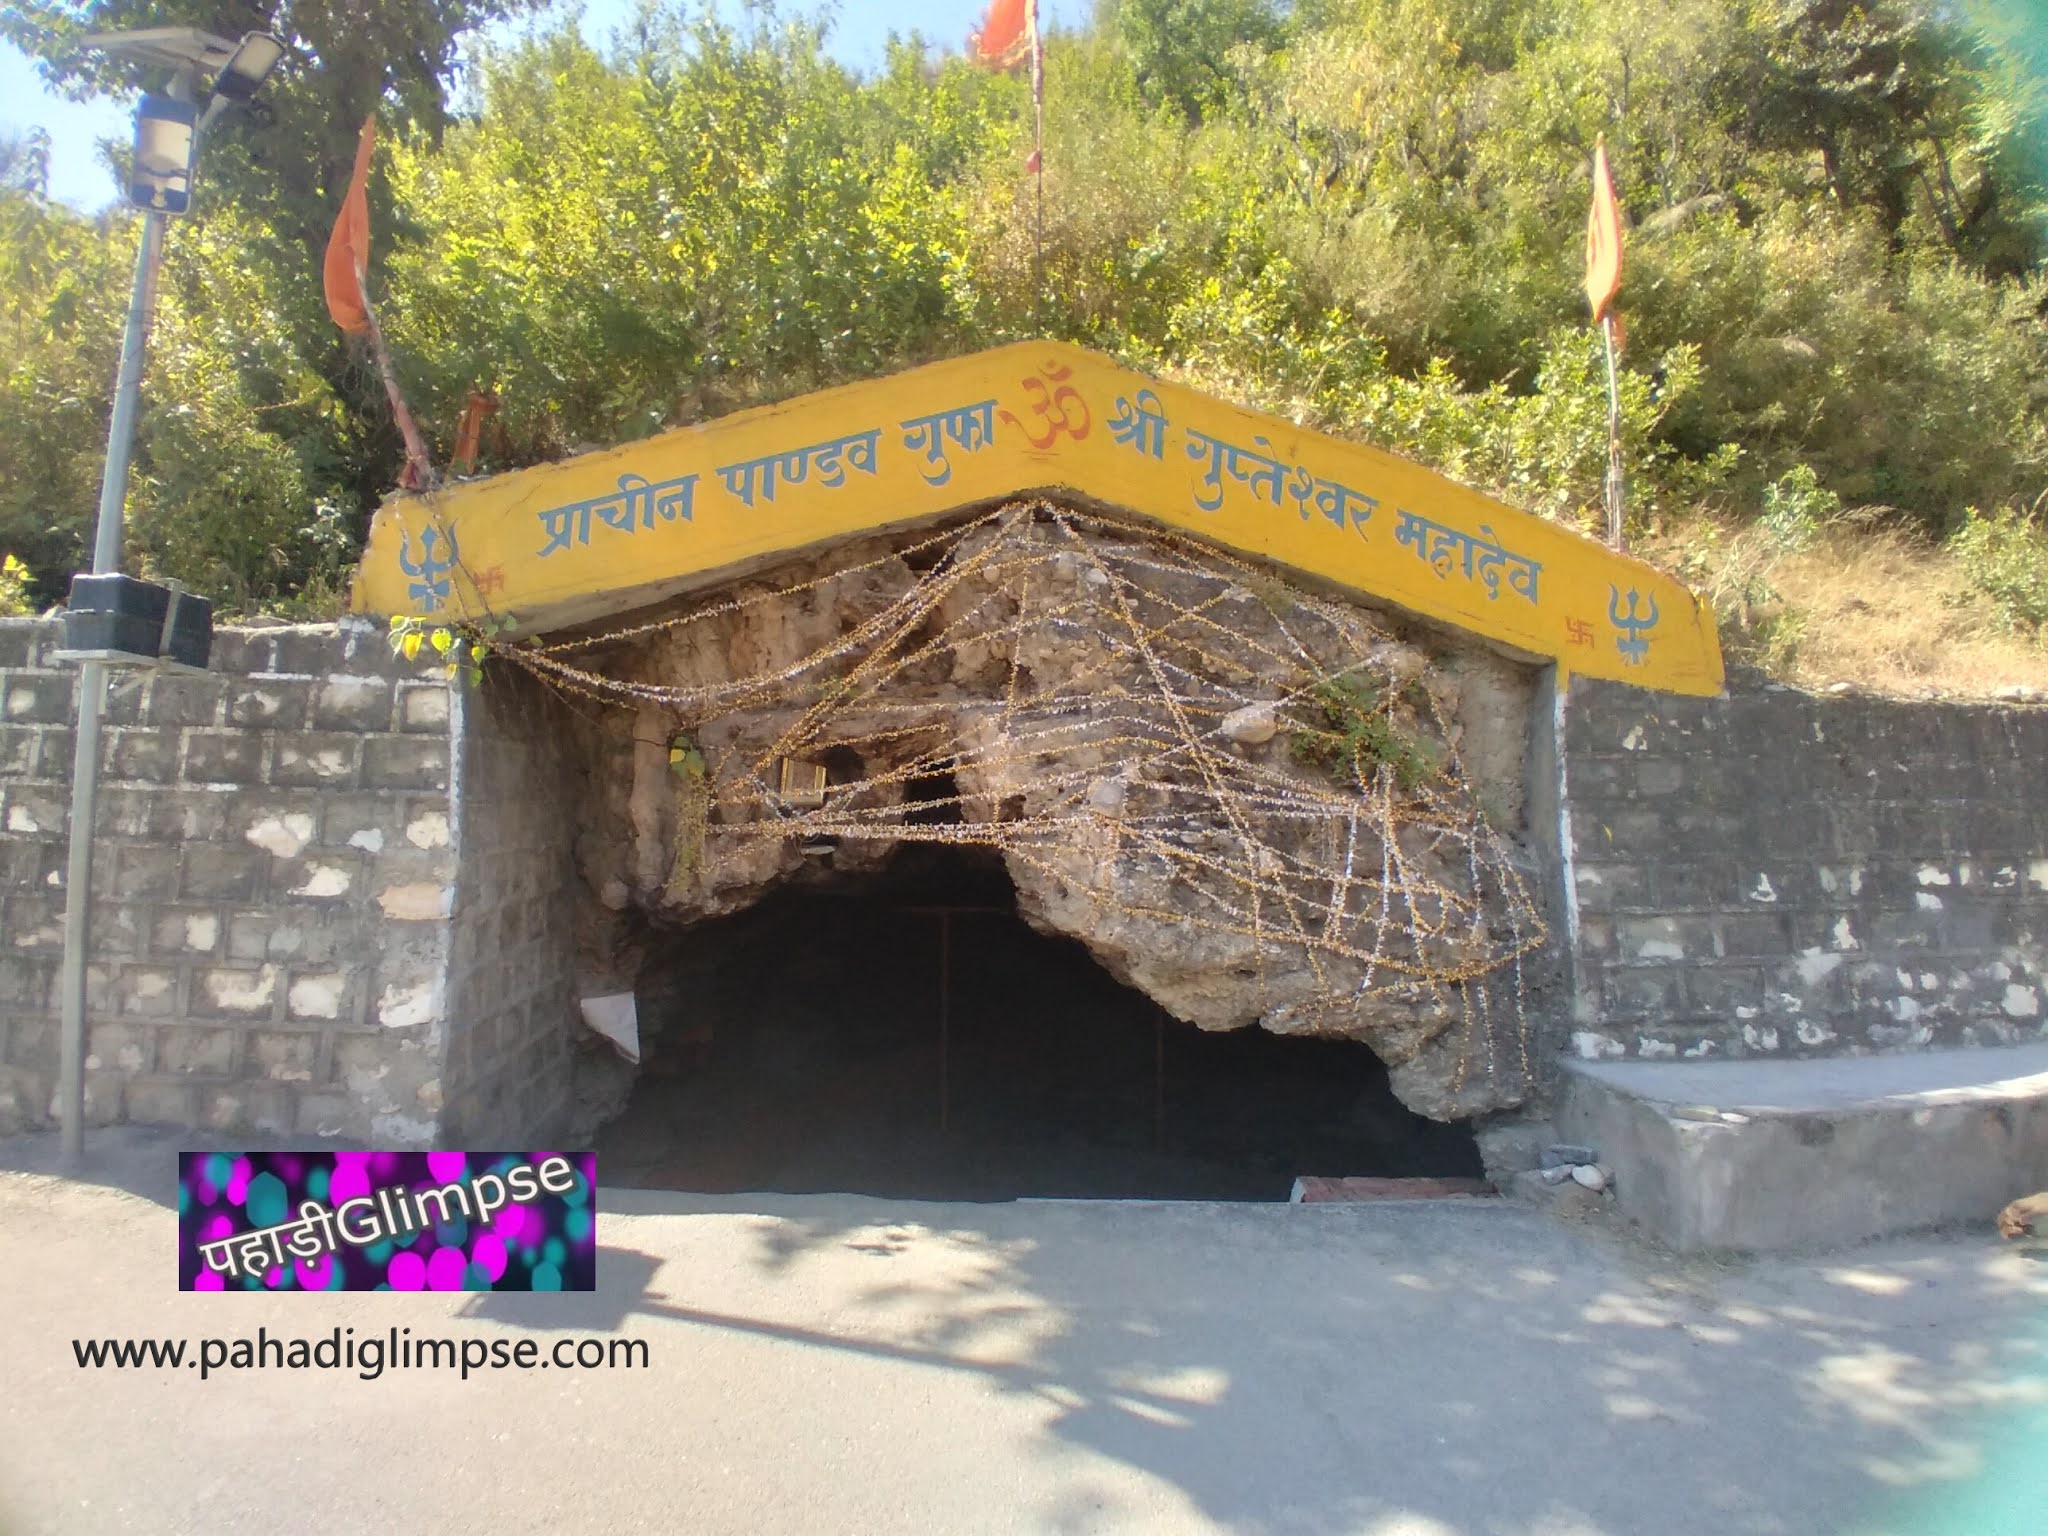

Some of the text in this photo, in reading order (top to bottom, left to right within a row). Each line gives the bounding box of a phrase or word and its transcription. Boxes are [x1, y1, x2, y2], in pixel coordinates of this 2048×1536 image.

[538, 474, 699, 556] प्राचीन
[716, 429, 882, 505] पाण्डव
[899, 400, 998, 486] गुफा
[1106, 389, 1169, 460] श्री
[1186, 429, 1378, 542] गुप्तेश्वर
[1395, 509, 1543, 605] महादेव
